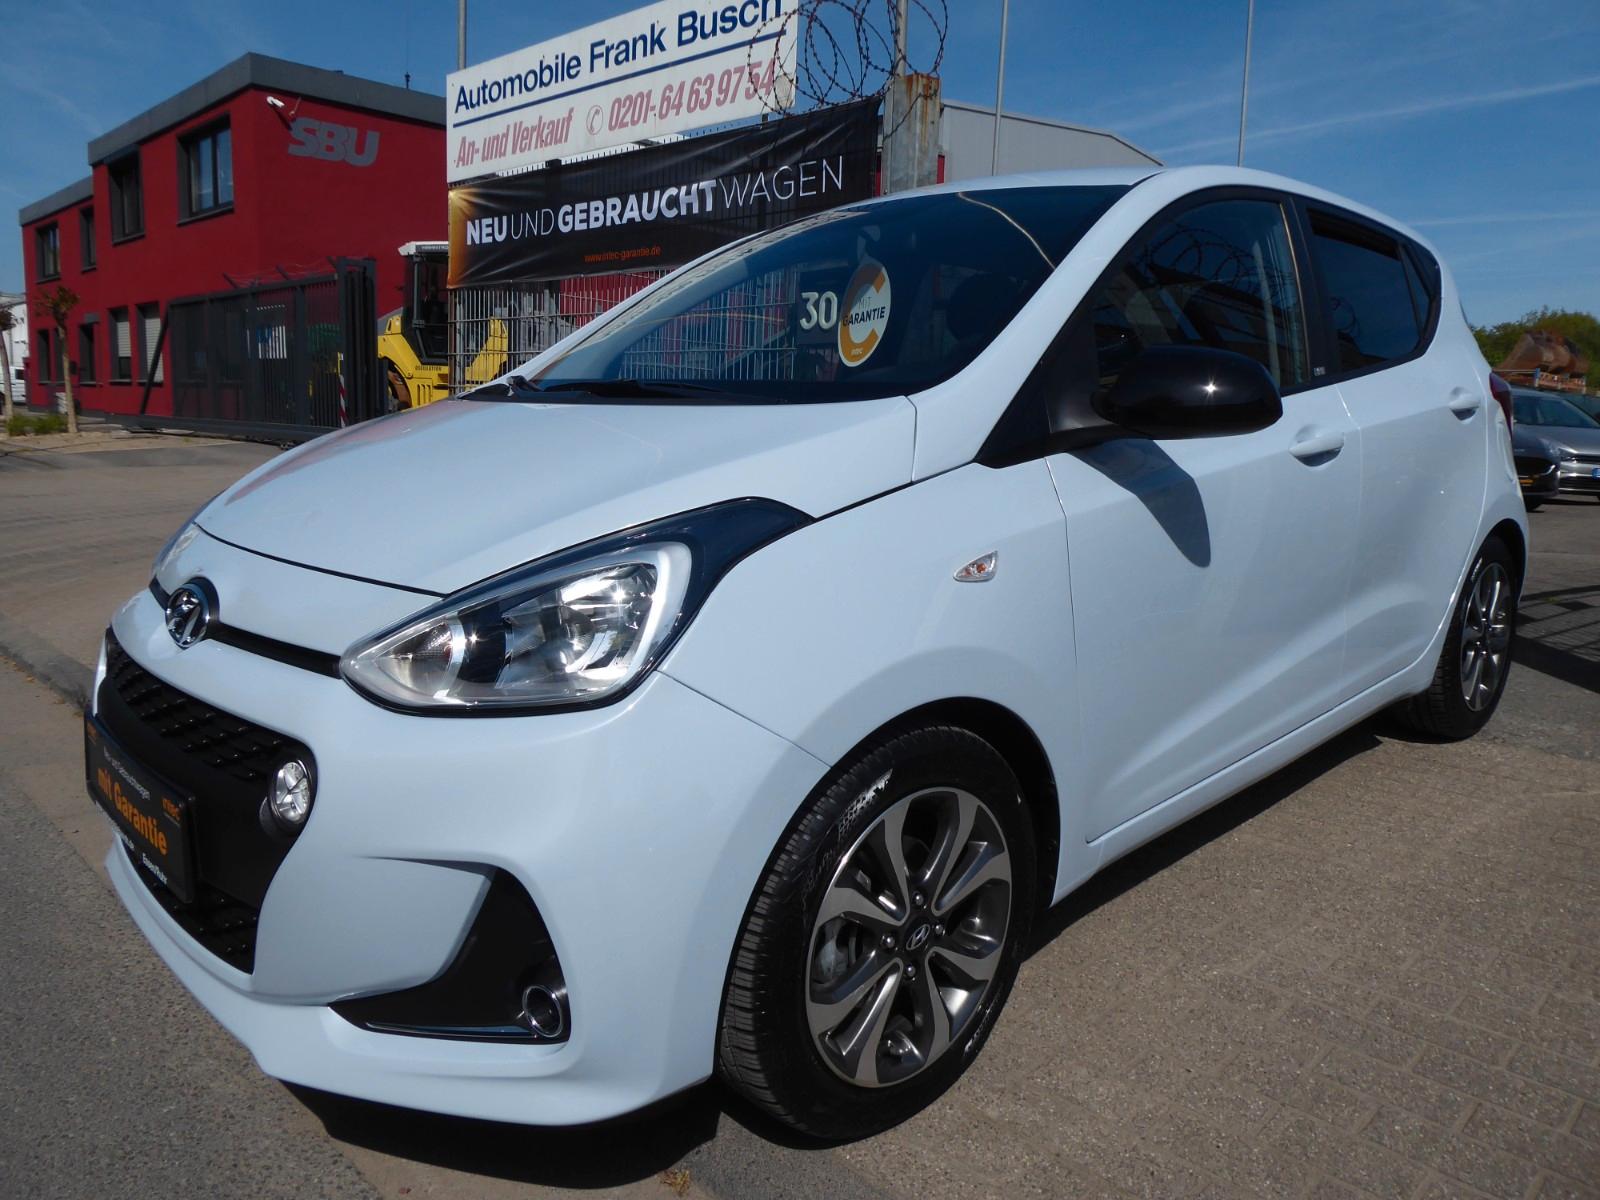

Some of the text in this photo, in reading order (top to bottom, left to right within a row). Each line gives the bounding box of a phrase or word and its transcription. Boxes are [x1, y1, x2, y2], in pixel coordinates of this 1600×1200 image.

[455, 52, 582, 114] Automobile
[590, 23, 667, 73] Frank
[288, 116, 380, 168] SBU
[456, 107, 575, 168] An- und Verkauf
[800, 290, 838, 330] 30
[842, 306, 886, 327] GARANTIE
[114, 782, 168, 856] Garantie
